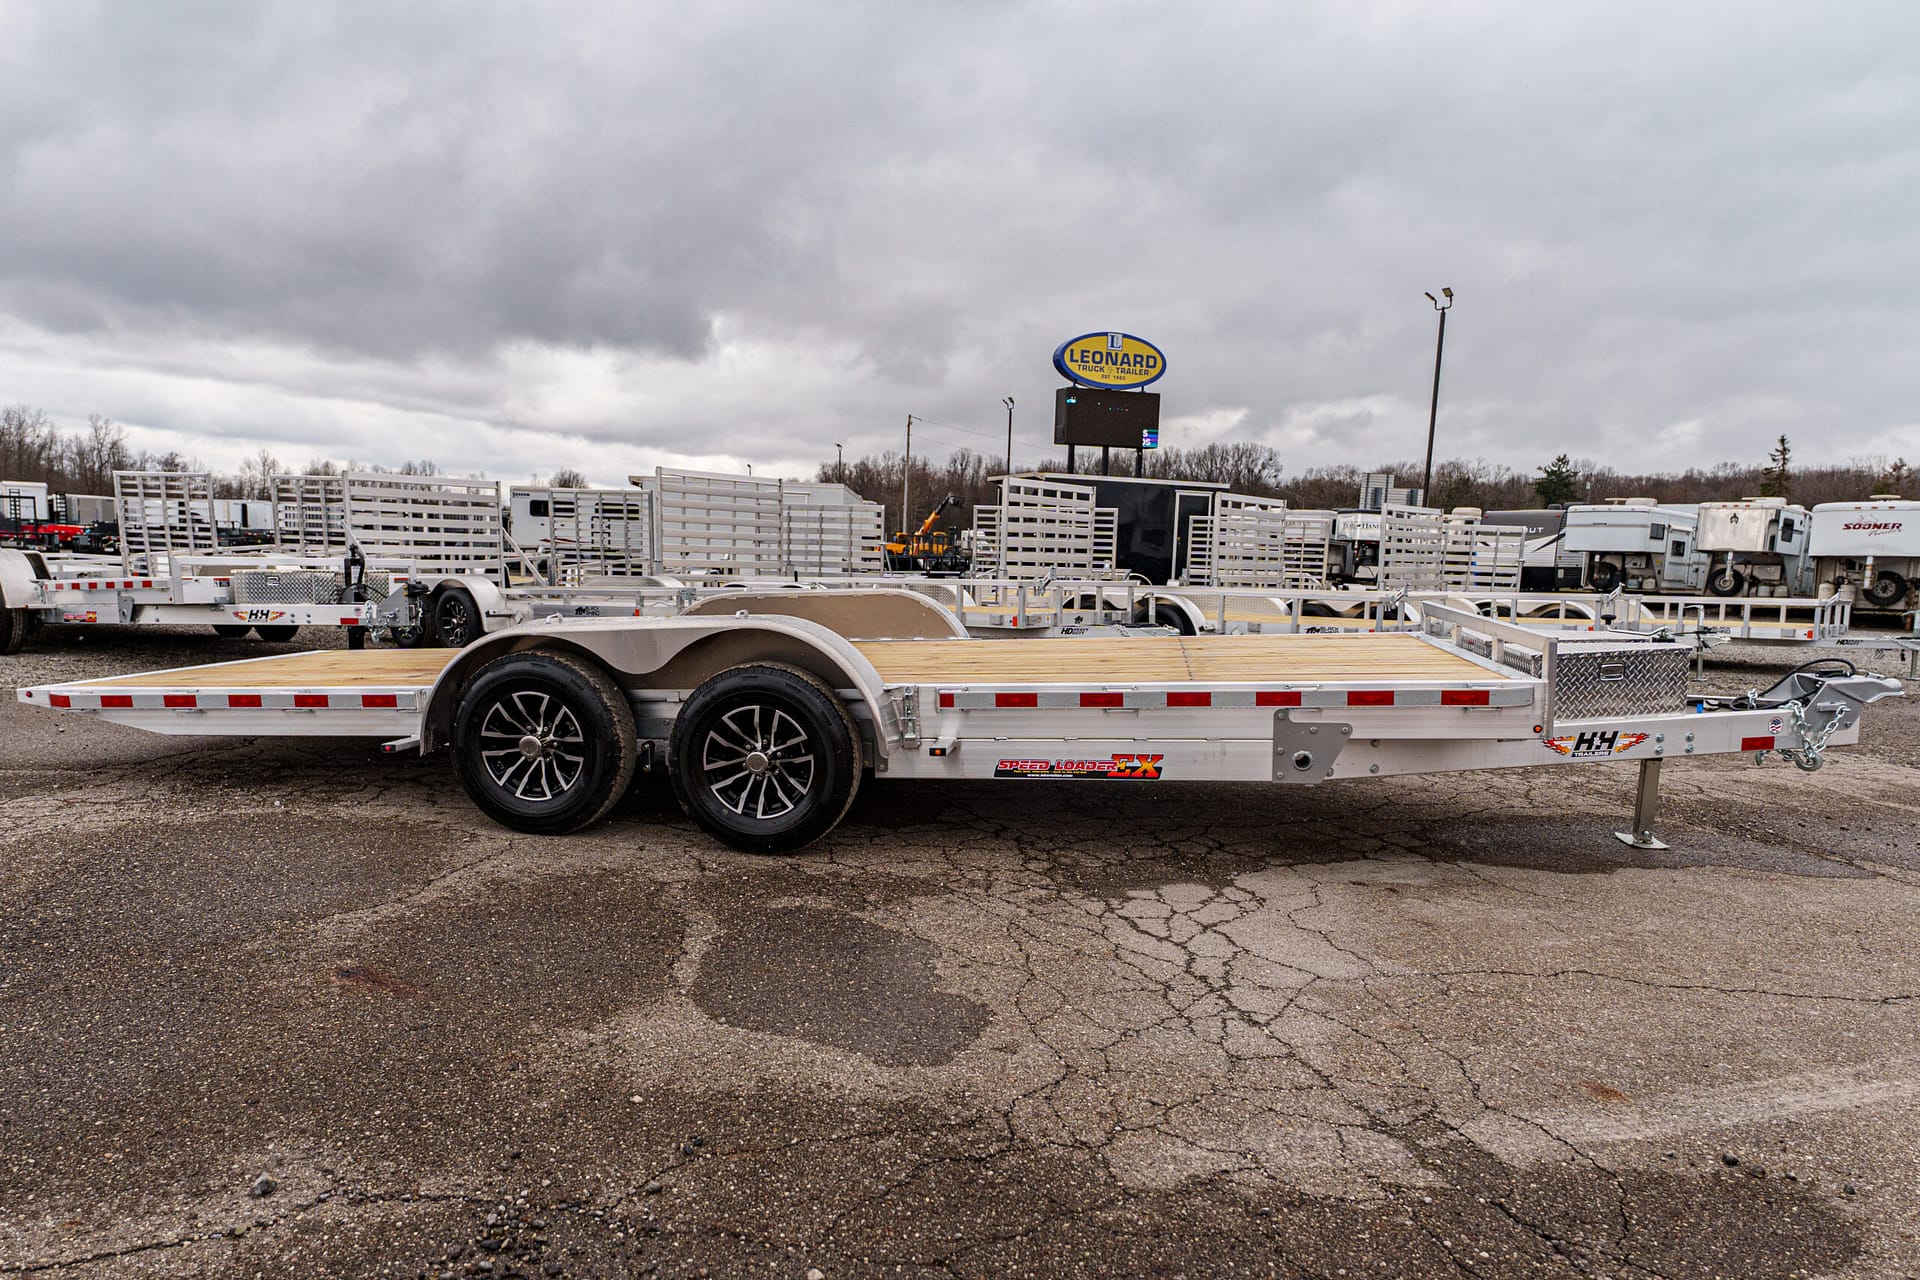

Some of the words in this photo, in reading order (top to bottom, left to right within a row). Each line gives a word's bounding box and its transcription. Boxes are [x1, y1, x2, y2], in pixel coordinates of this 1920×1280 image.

[1069, 348, 1158, 369] LEONARD
[1077, 364, 1105, 373] TRUCK
[1115, 366, 1149, 376] TRAILER
[1842, 522, 1903, 531] SOONER
[997, 759, 1051, 771] SPEED
[1055, 759, 1119, 772] LOADER
[1106, 753, 1165, 778] EX
